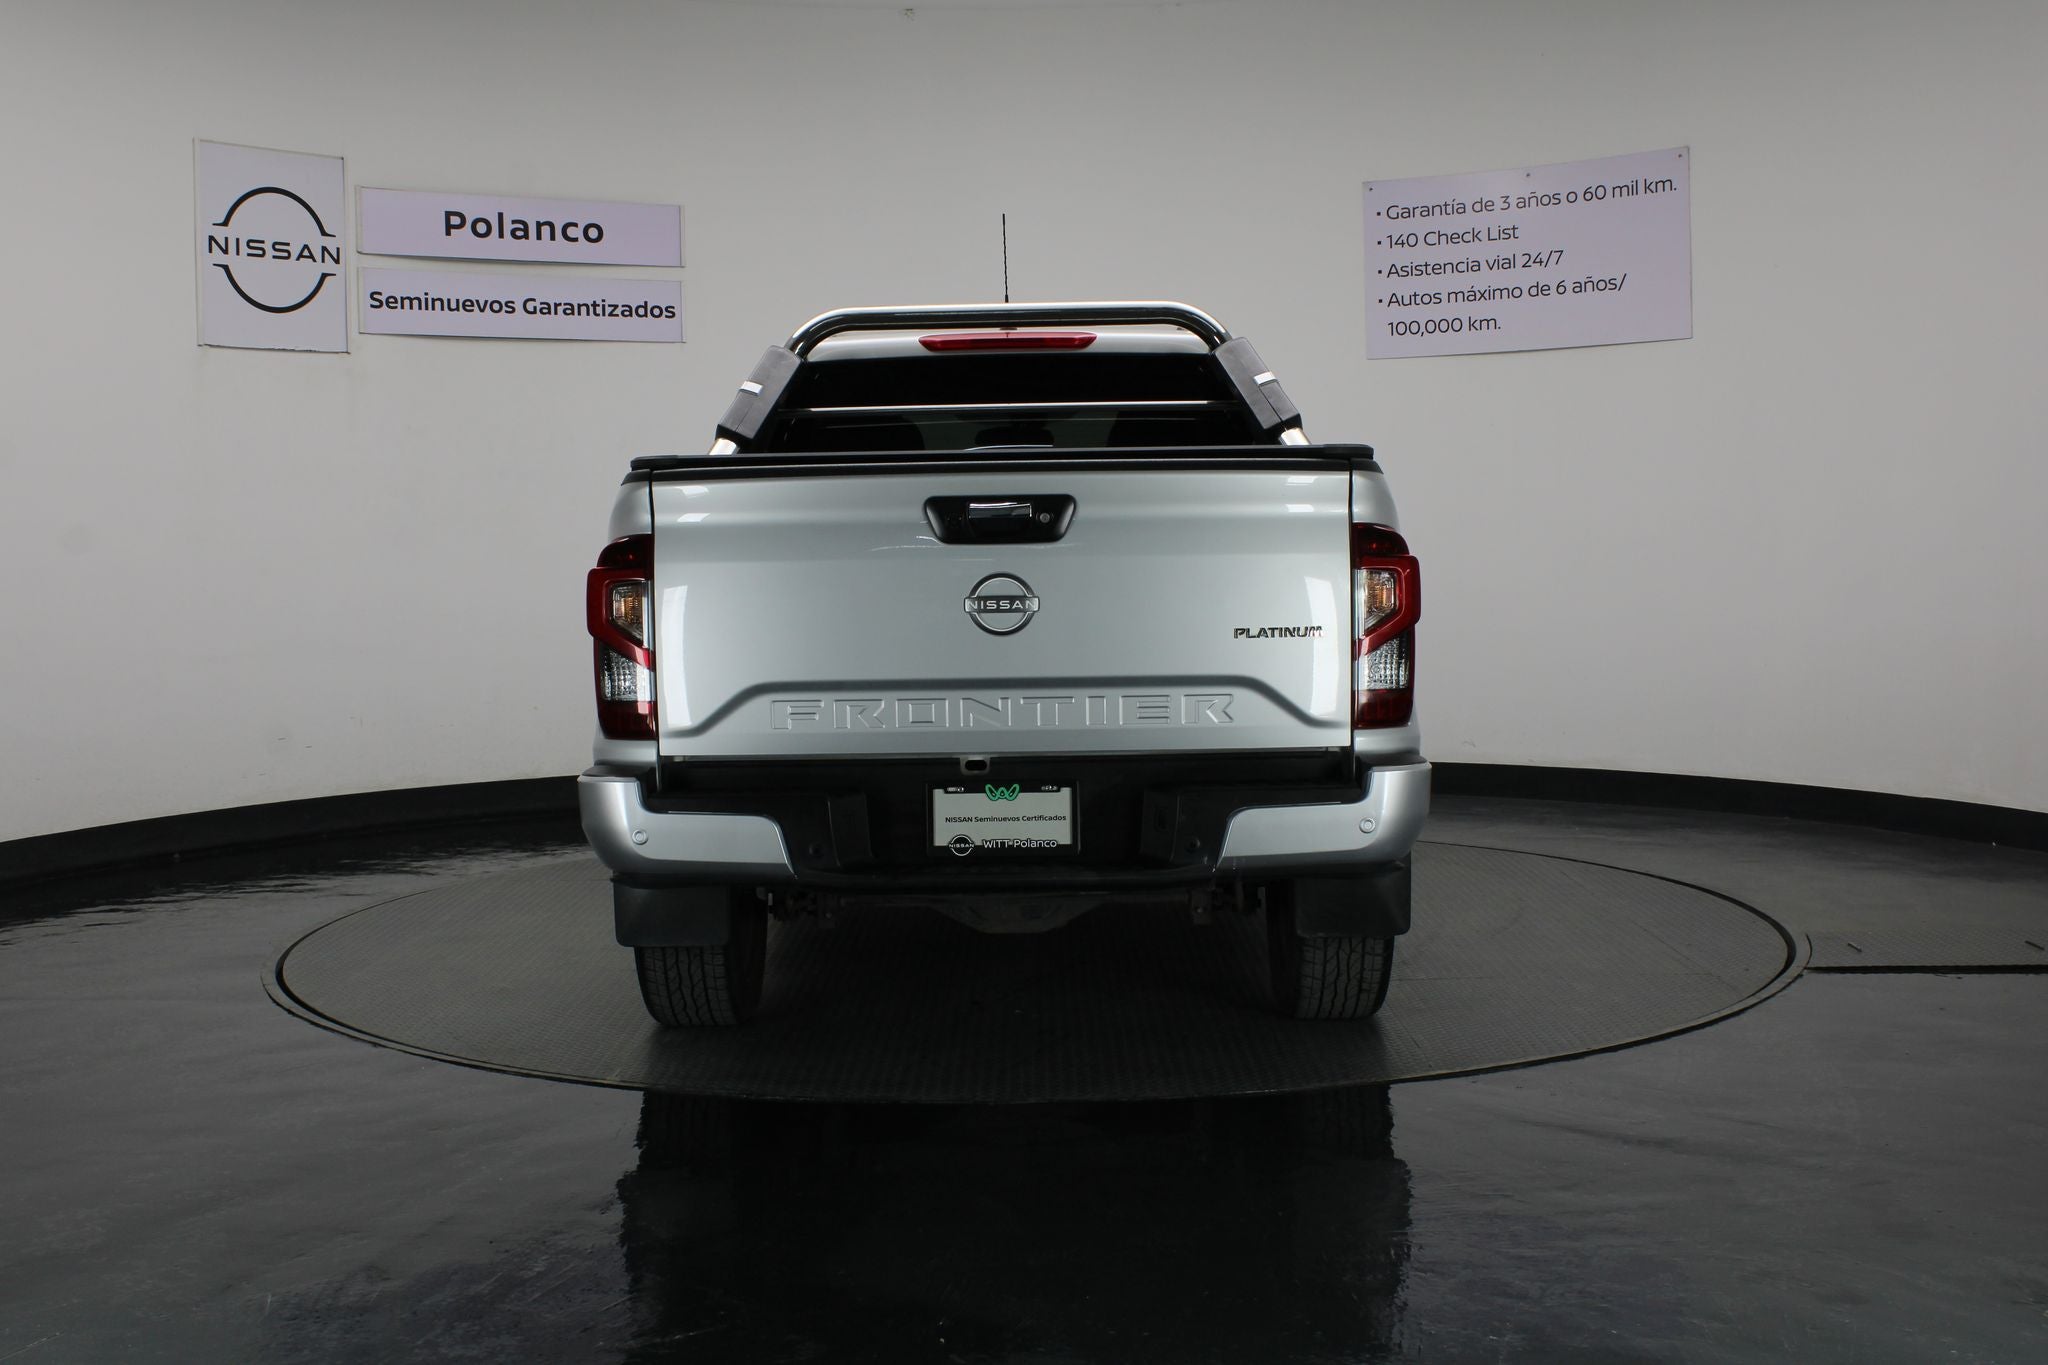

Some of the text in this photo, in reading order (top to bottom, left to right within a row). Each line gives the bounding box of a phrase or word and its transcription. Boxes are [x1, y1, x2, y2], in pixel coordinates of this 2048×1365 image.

[1386, 177, 1677, 221] Garantía de 3 años o 60 mil km.
[444, 210, 604, 244] Polanco
[1385, 224, 1520, 249] 140 Check List
[207, 234, 341, 265] NISSAN
[1386, 249, 1564, 279] Asistencia vial 24/7
[369, 290, 676, 320] Seminuevos Garantizados
[1386, 272, 1627, 308] Autos máximo de 6 años/
[1387, 315, 1501, 338] 100,000 km.
[966, 599, 1037, 611] NISSAN
[1234, 626, 1322, 639] PLATINUM
[770, 694, 1235, 729] FRONTIER
[1021, 814, 1067, 823] Certificados
[983, 838, 1058, 848] WITT Polanco
